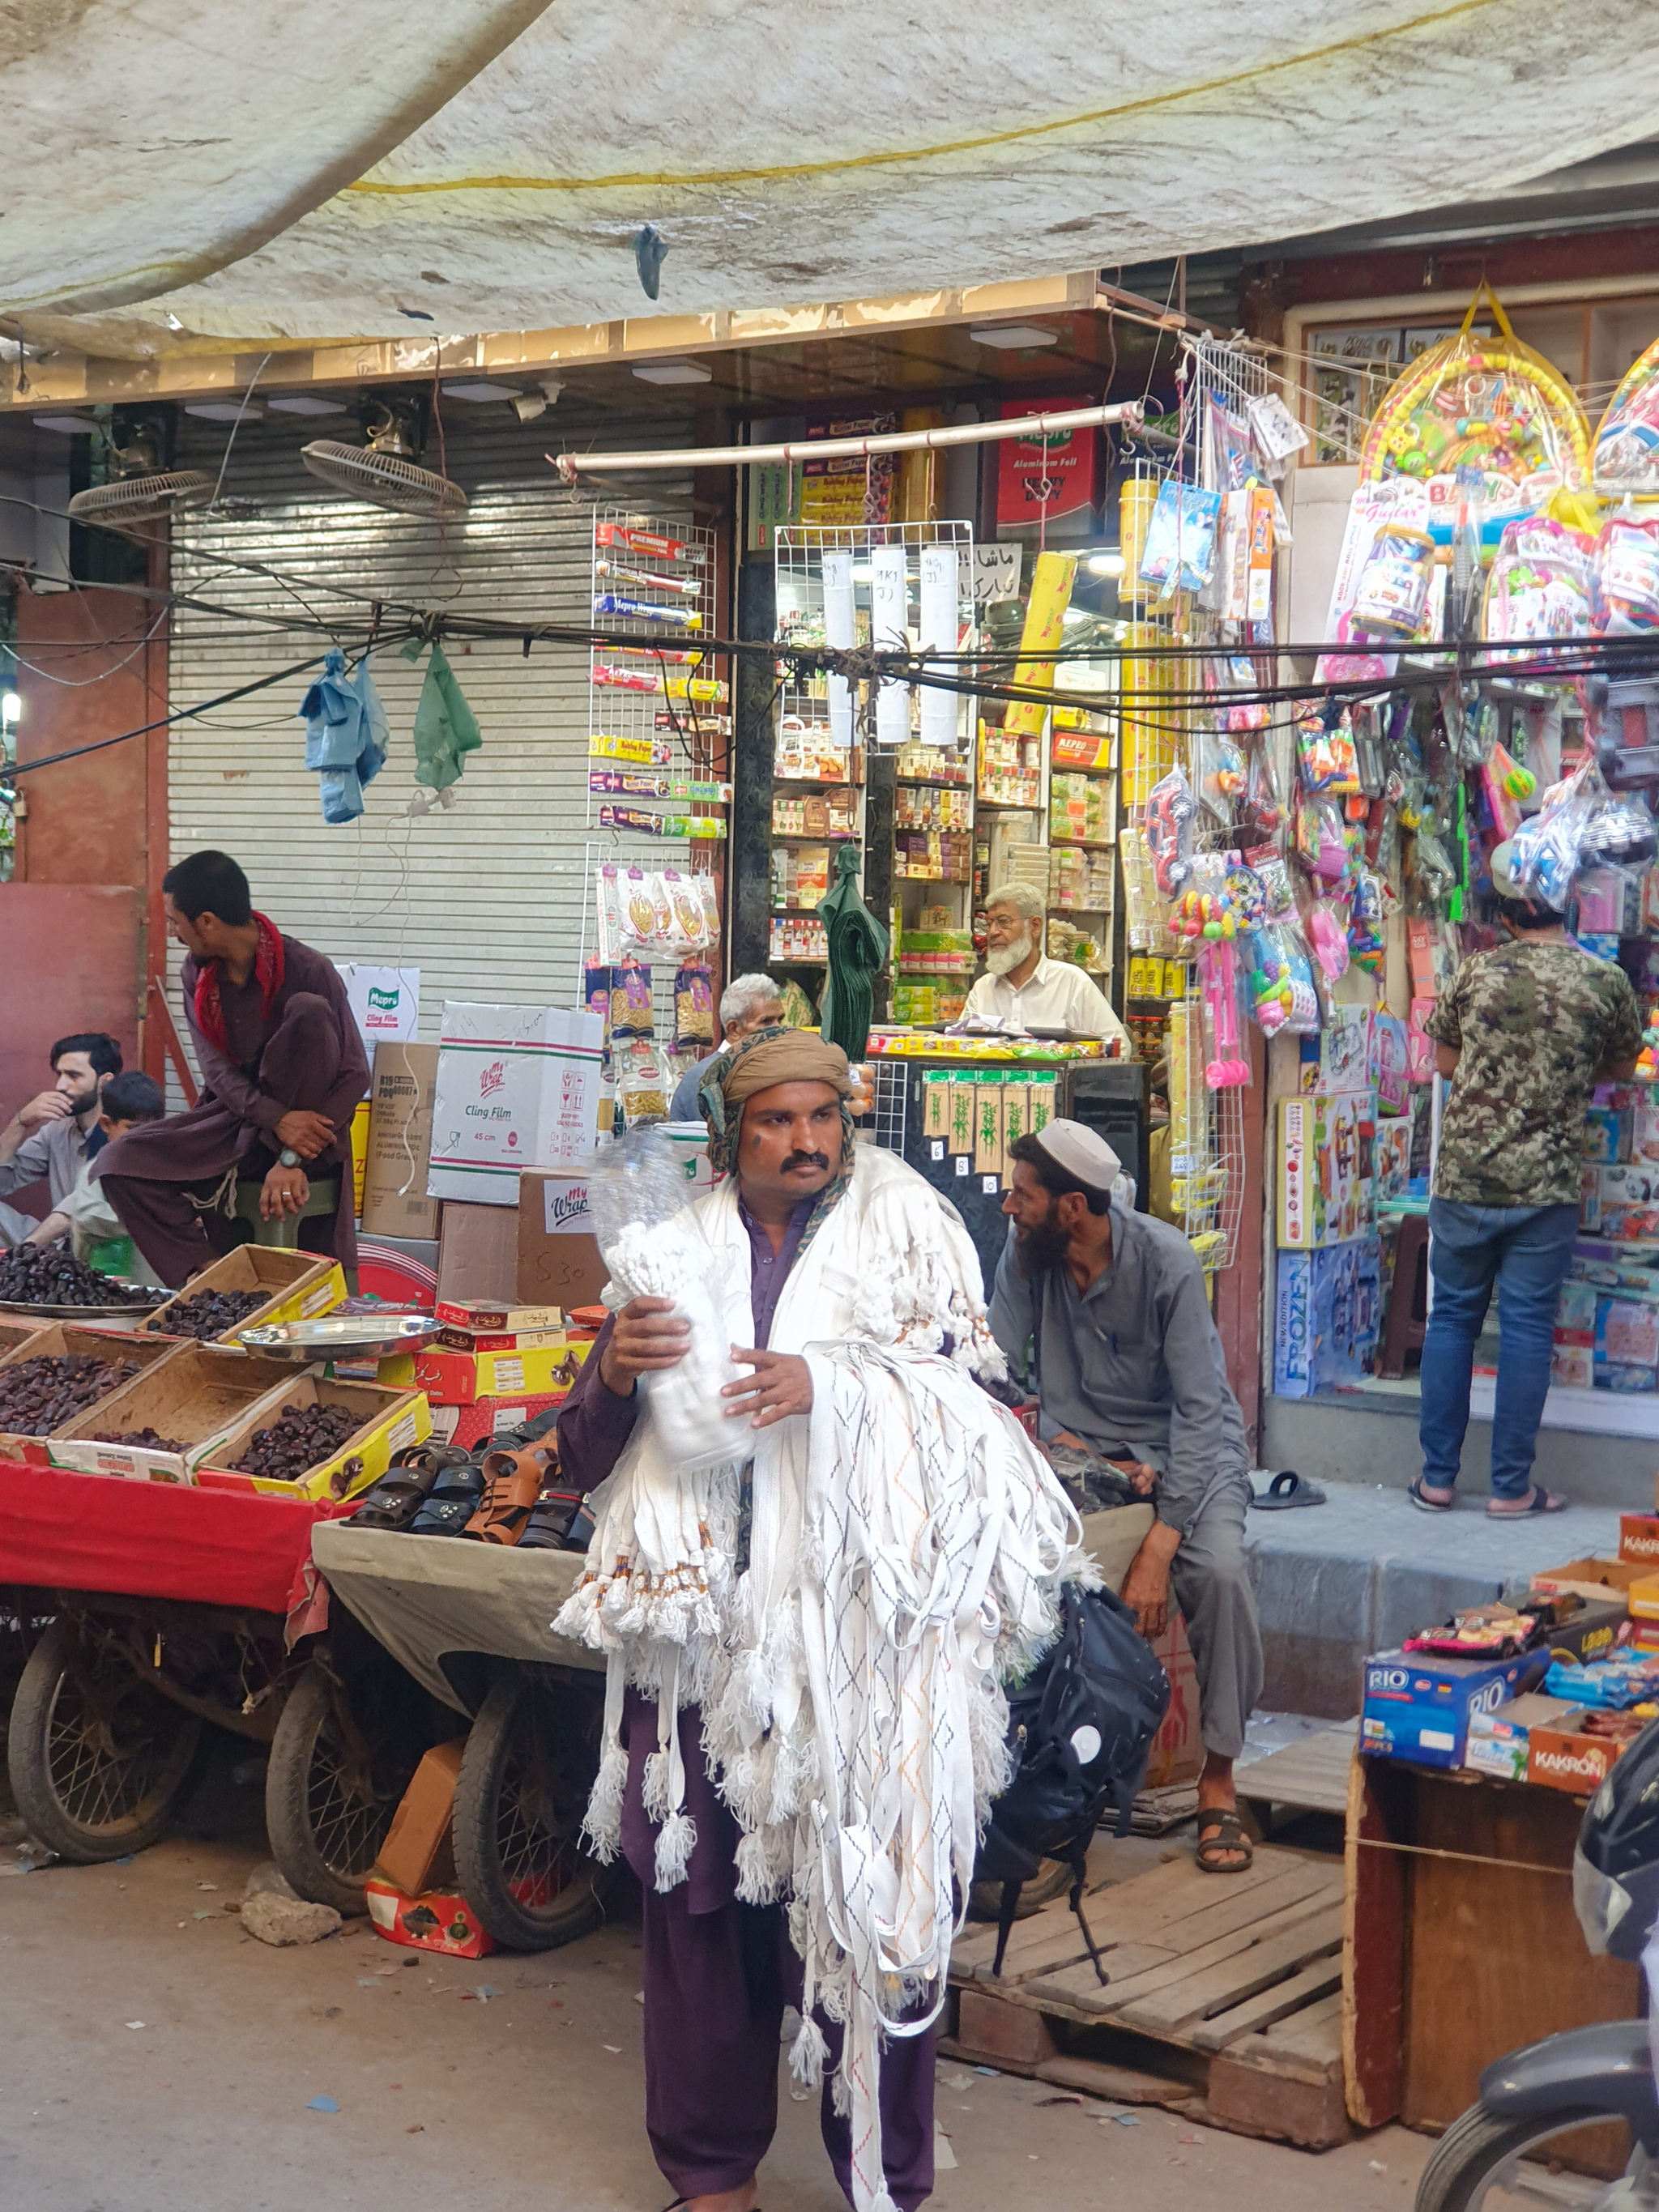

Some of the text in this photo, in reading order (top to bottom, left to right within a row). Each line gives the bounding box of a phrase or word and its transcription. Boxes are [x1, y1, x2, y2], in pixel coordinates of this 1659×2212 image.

[851, 457, 866, 467] Pape
[1013, 458, 1077, 468] Aluminum Foil
[1025, 490, 1062, 501] DTY
[1430, 480, 1501, 504] BAY
[630, 533, 669, 548] PREMIUM
[1059, 738, 1086, 750] MEPRO
[1255, 853, 1278, 865] Animal
[370, 992, 398, 1008] Mepro
[367, 1014, 398, 1024] Cling Film
[465, 1105, 512, 1120] Cling Film
[395, 1153, 418, 1161] Gra)
[551, 1196, 588, 1218] Wrap
[1286, 1259, 1309, 1381] FROZEN
[1369, 1670, 1407, 1690] RIO
[1535, 1750, 1601, 1776] KAKRON
